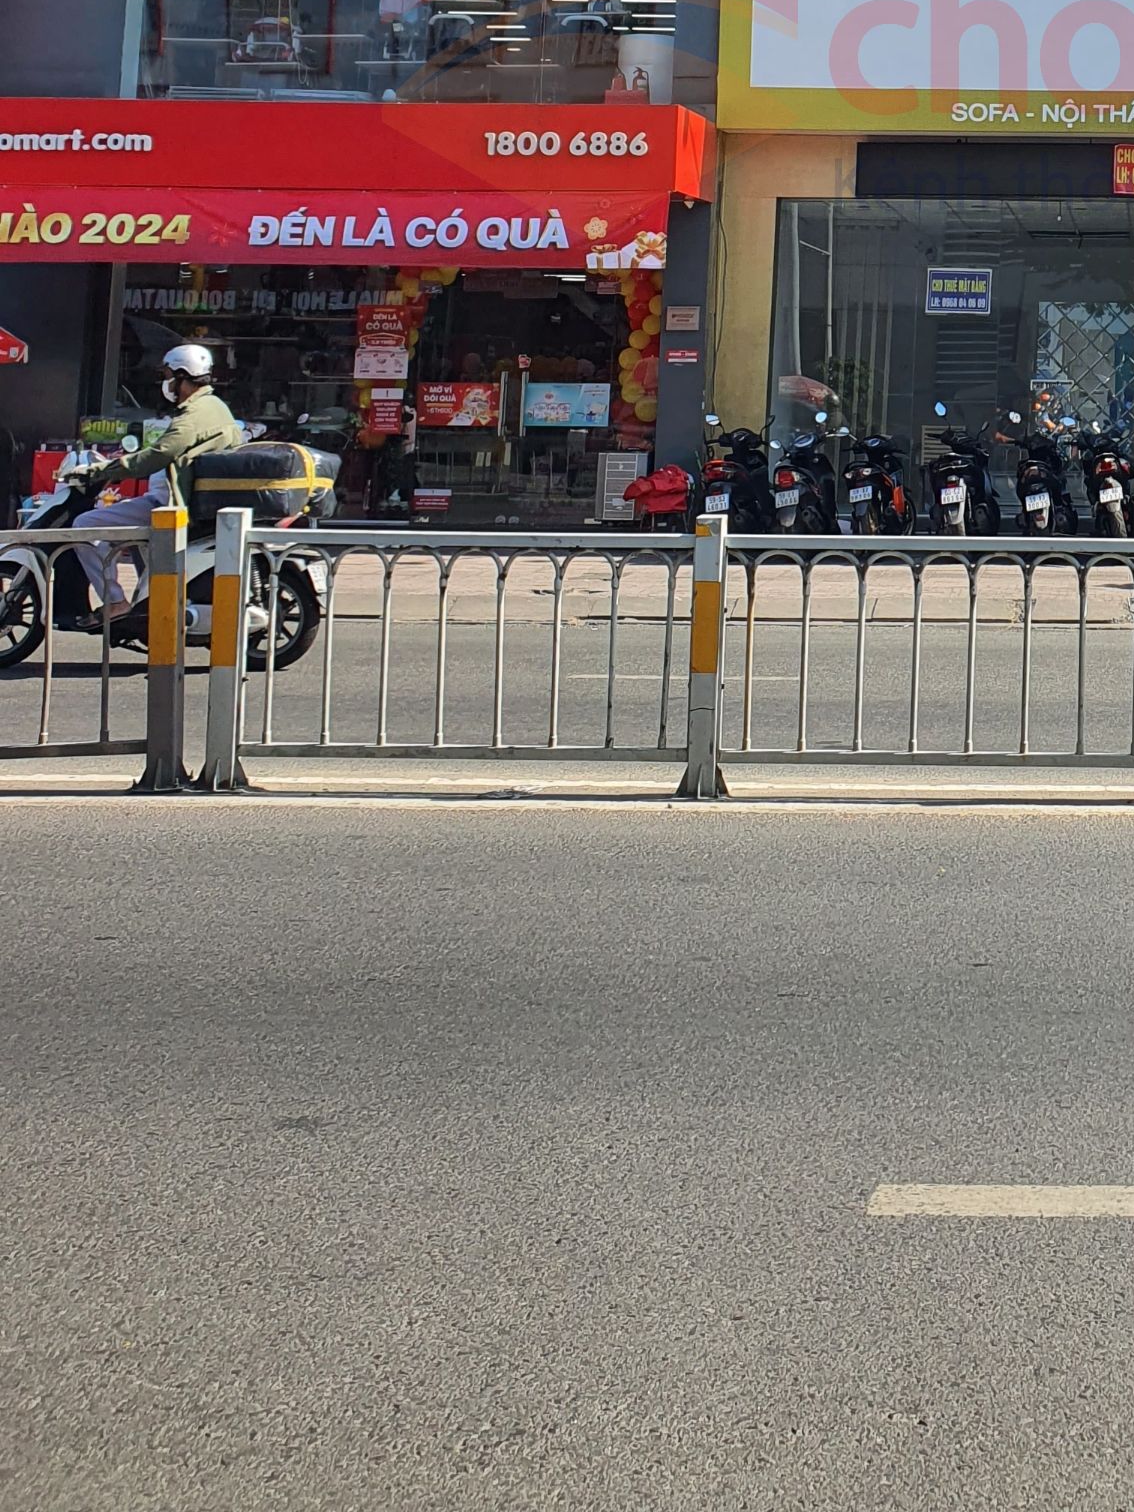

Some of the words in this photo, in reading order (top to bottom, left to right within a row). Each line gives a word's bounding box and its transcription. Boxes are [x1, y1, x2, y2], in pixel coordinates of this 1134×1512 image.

[951, 102, 1019, 123] SOFA
[1042, 99, 1086, 128] NỘI
[484, 131, 561, 157] 1800
[569, 131, 649, 157] 6886
[78, 213, 191, 246] 2024
[248, 207, 337, 247] ĐẾN
[342, 209, 395, 247] LÀ
[404, 209, 468, 249] CÓ
[476, 208, 571, 250] QUÀ
